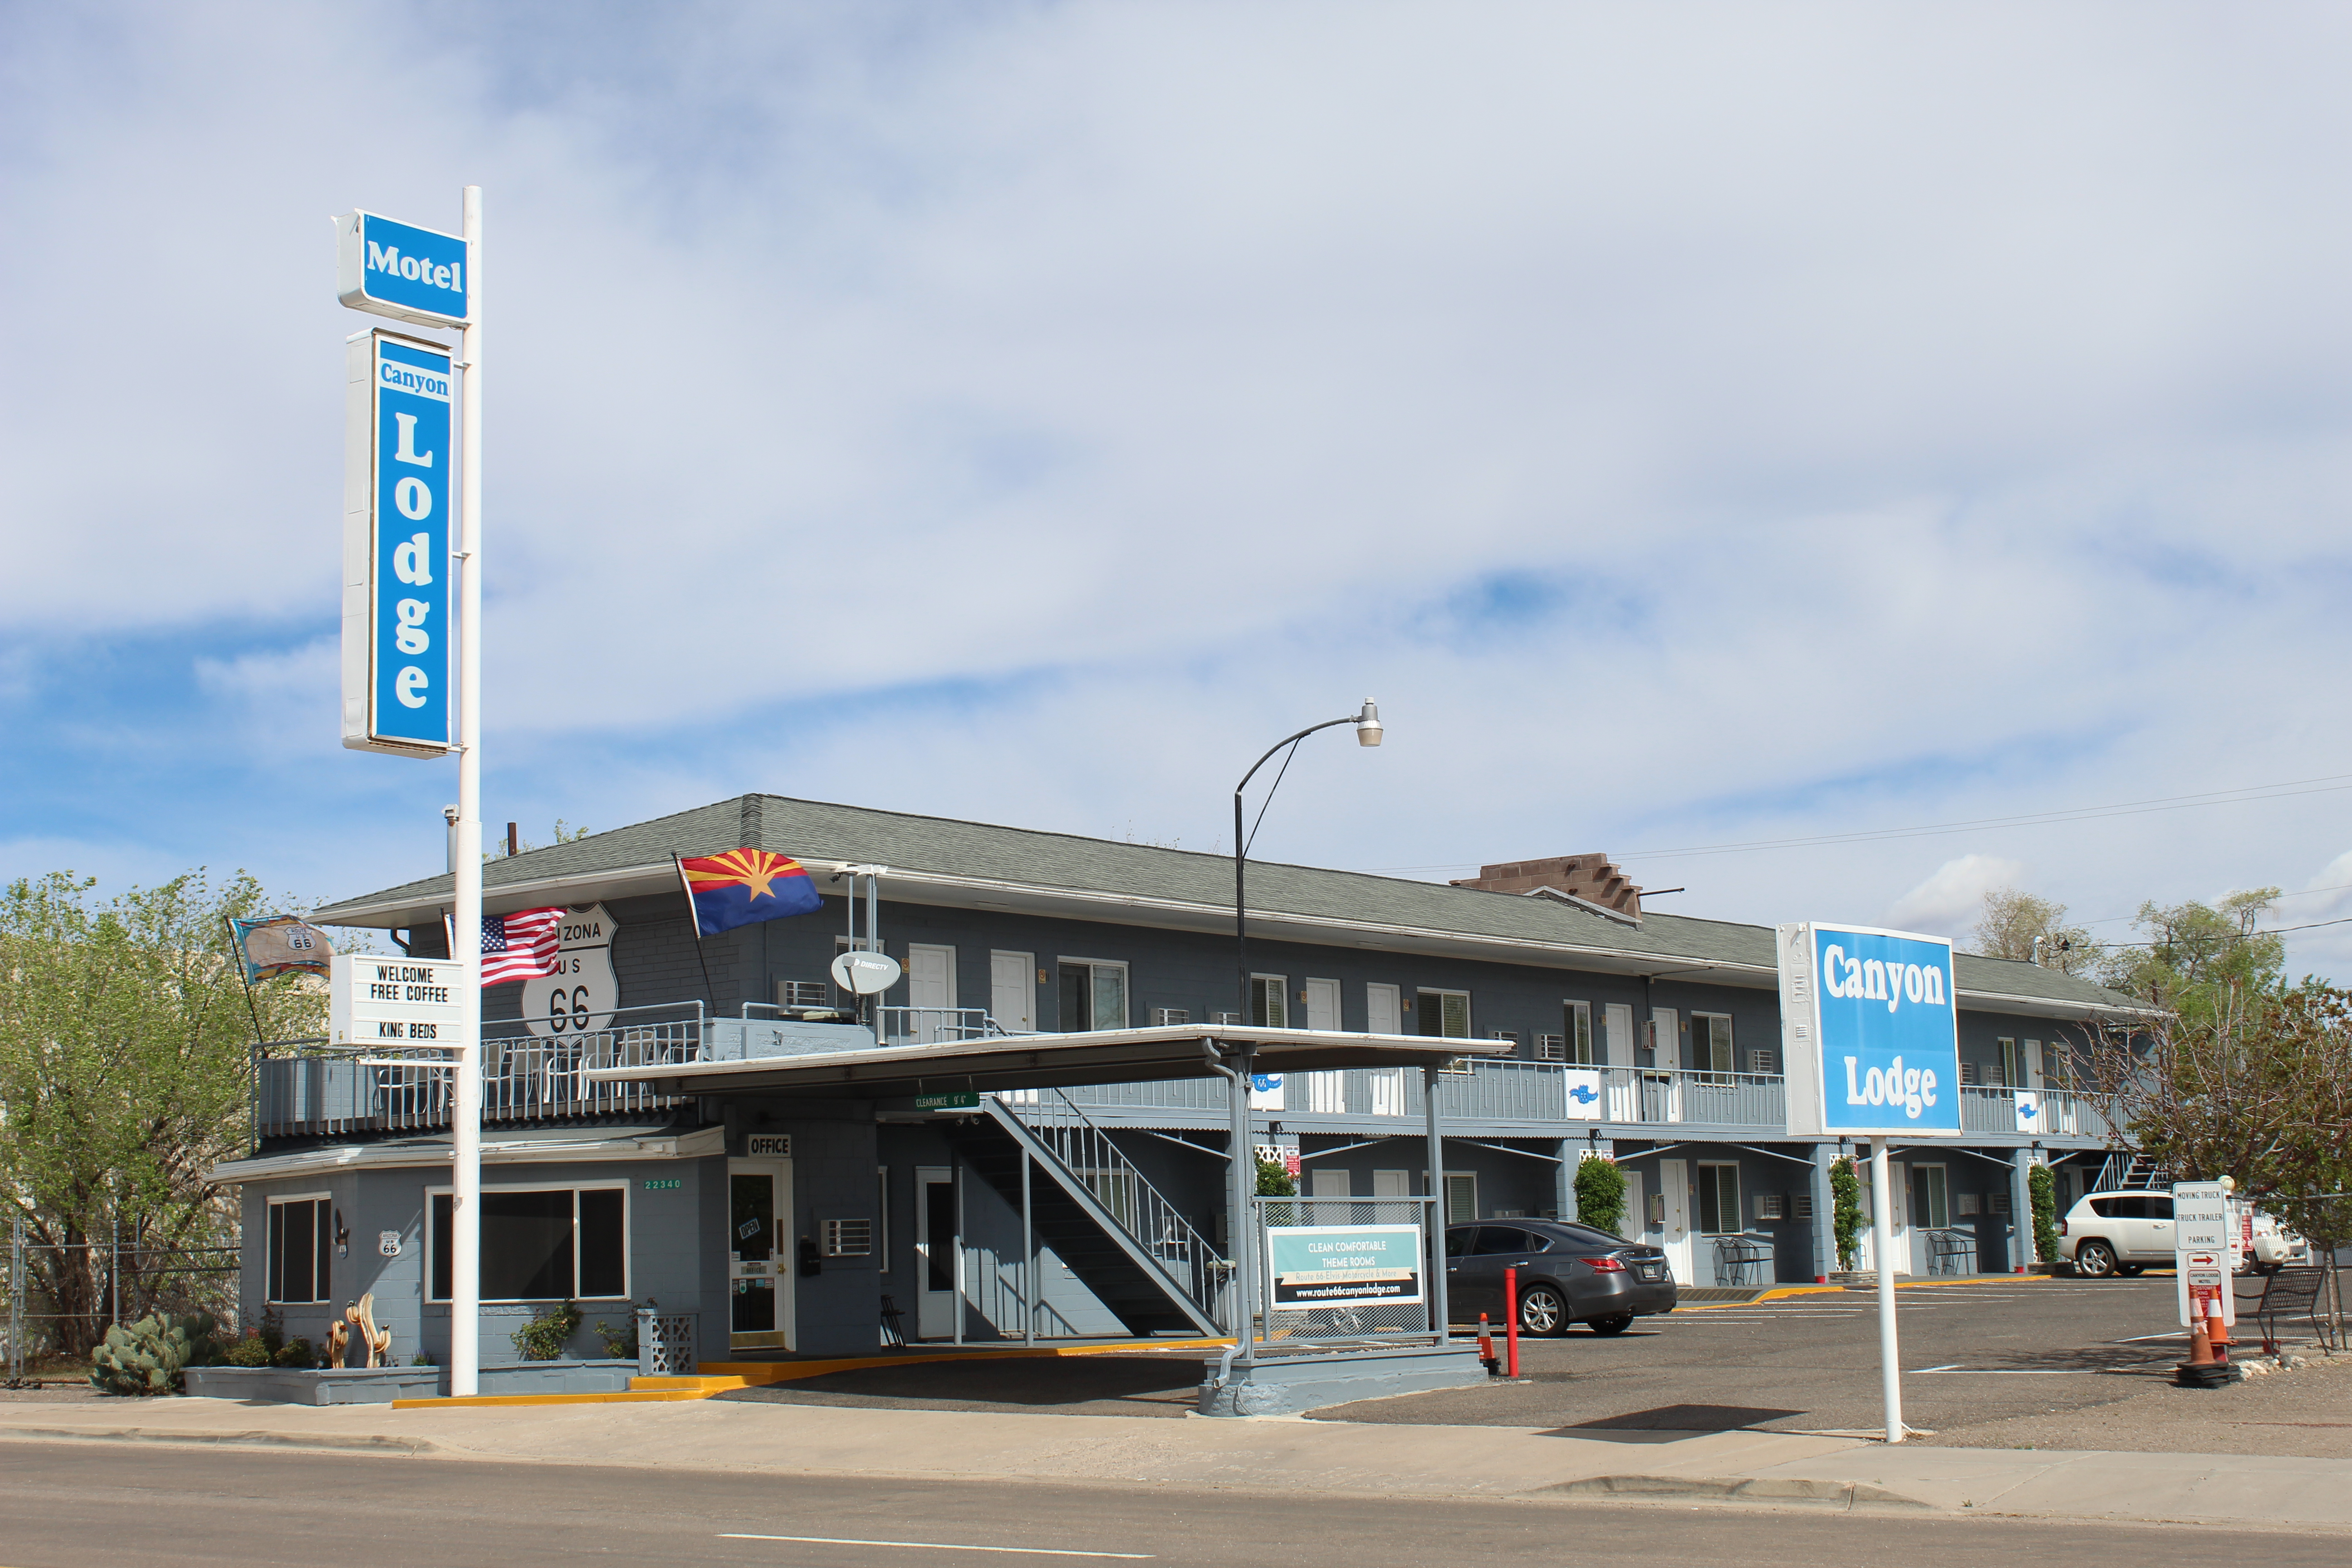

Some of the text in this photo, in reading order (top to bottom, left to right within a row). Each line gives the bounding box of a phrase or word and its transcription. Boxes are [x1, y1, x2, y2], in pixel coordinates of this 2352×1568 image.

[368, 240, 462, 293] Motel
[381, 363, 449, 396] Canyon
[394, 412, 433, 709] Lodge
[558, 922, 601, 941] IZONA
[294, 939, 312, 948] 66
[377, 965, 433, 983] WELCOME
[860, 961, 888, 970] DIRECTV
[1824, 944, 1945, 1013] Canyon
[371, 984, 448, 1002] FREE COFFEE
[550, 985, 589, 1033] 66
[380, 1022, 436, 1039] KING BEDS
[1844, 1055, 1937, 1119] Lodge
[916, 1097, 947, 1107] CLEARANCE
[751, 1138, 789, 1153] OFFICE
[645, 1180, 680, 1189] 22340
[741, 1219, 759, 1237] OPEN
[384, 1244, 396, 1253] 66
[1308, 1240, 1386, 1253] CLEAN COMFORTABLE
[1322, 1256, 1375, 1268] THEME ROOMS
[1296, 1269, 1397, 1281] Route 66-Elvis-Motorcycle & More
[1296, 1282, 1401, 1297] www.route66canyonlodge.com
